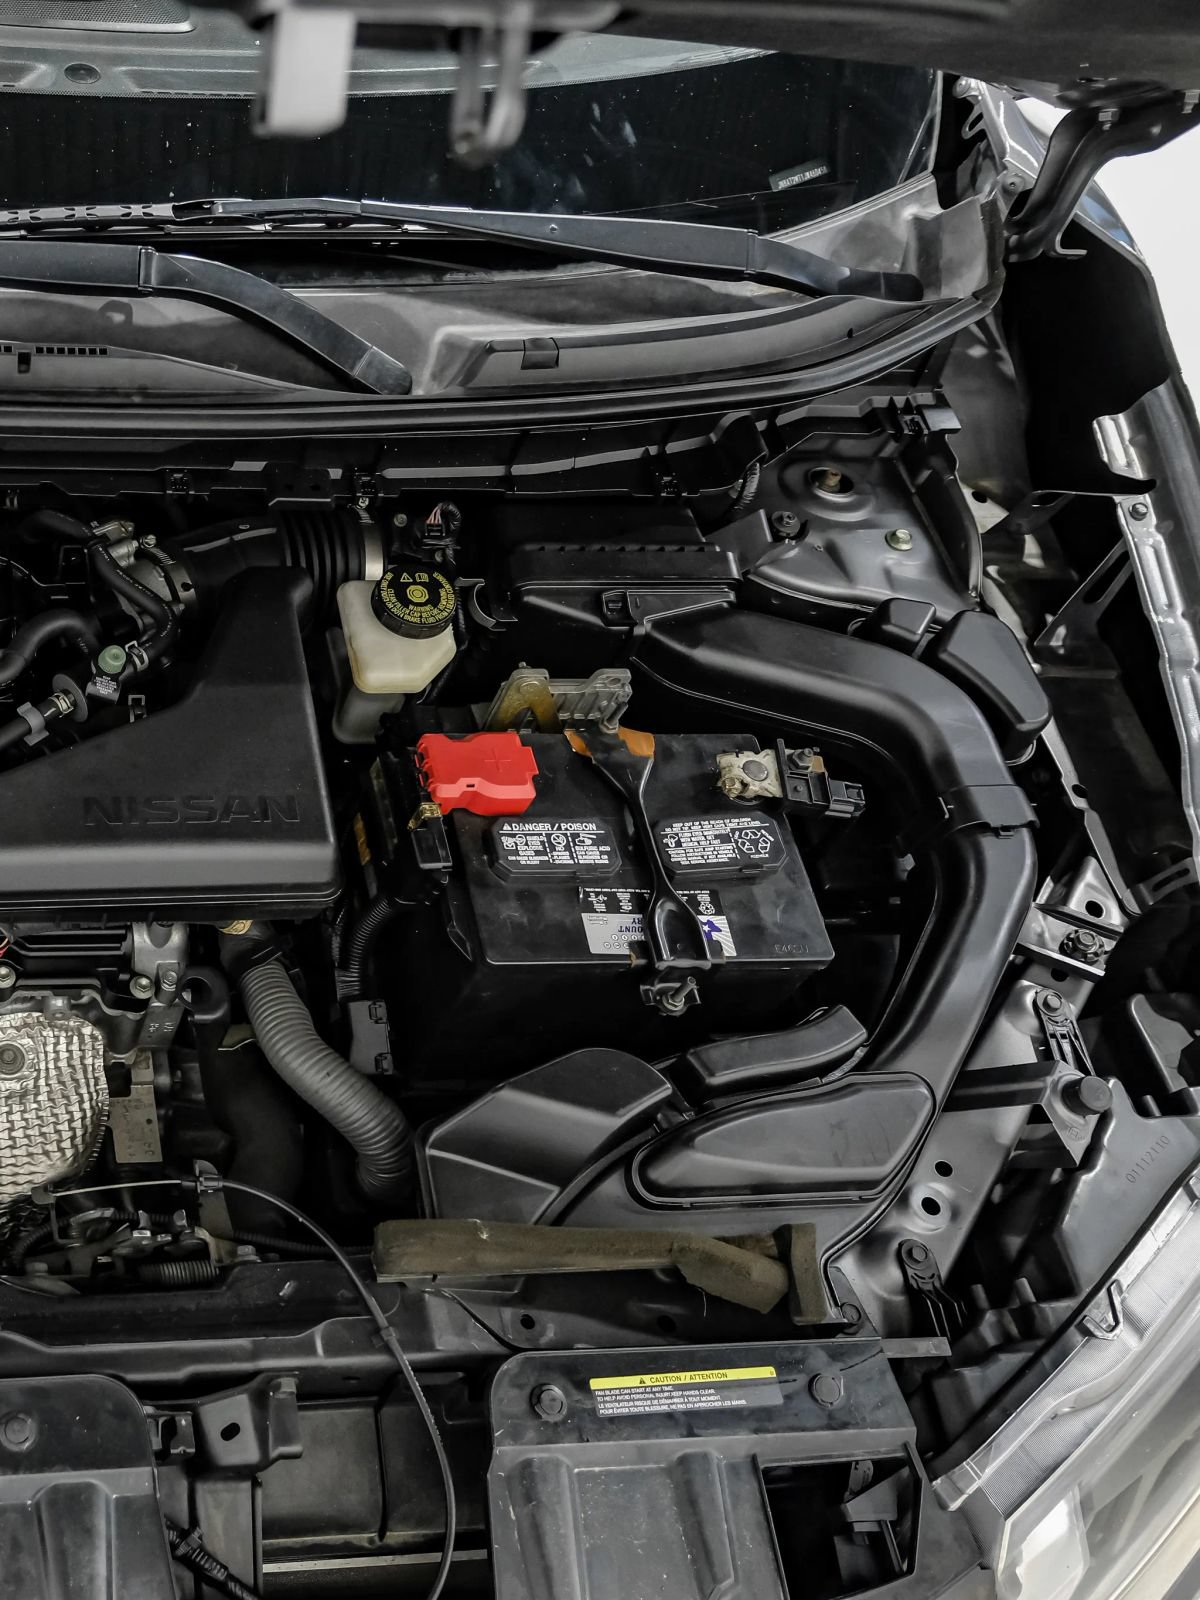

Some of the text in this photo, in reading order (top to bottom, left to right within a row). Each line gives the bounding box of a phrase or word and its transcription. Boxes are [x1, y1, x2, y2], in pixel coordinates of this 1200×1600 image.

[409, 604, 433, 613] WARNING
[404, 614, 421, 623] BRAKE
[83, 795, 300, 826] NISSAN
[1125, 1135, 1169, 1183] 01112110
[689, 1372, 728, 1381] ATTENTION
